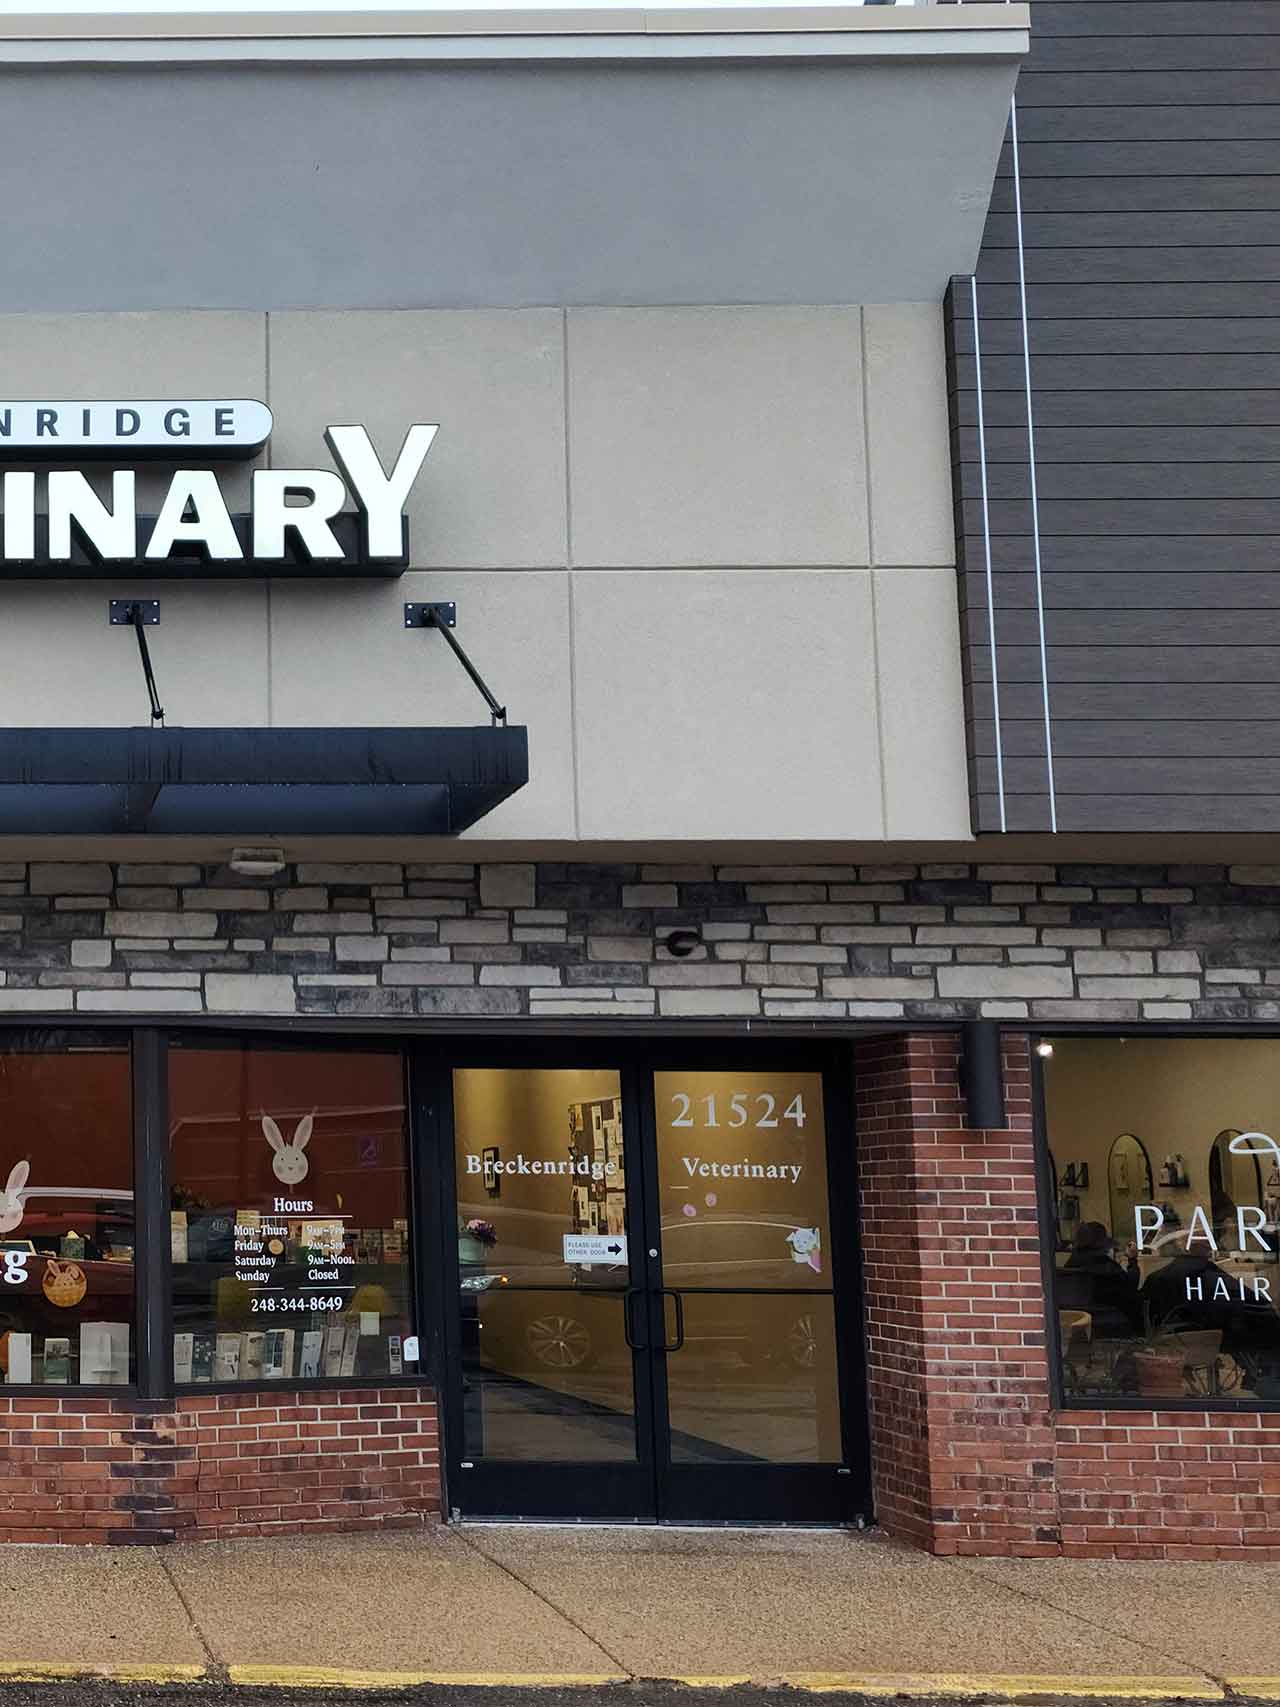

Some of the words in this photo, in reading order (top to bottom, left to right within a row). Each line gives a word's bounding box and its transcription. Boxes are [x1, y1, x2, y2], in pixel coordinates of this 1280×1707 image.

[671, 1093, 807, 1128] 21524
[466, 1154, 616, 1181] Breckenridge
[682, 1157, 802, 1183] Veterinary
[273, 1197, 314, 1212] Hours
[1134, 1205, 1272, 1251] PAR
[234, 1240, 265, 1253] Friday
[234, 1254, 277, 1268] Saturday
[235, 1270, 270, 1283] Sunday
[308, 1268, 339, 1281] Closed
[1185, 1276, 1273, 1302] HAIR
[250, 1296, 343, 1312] 248-344-8649
